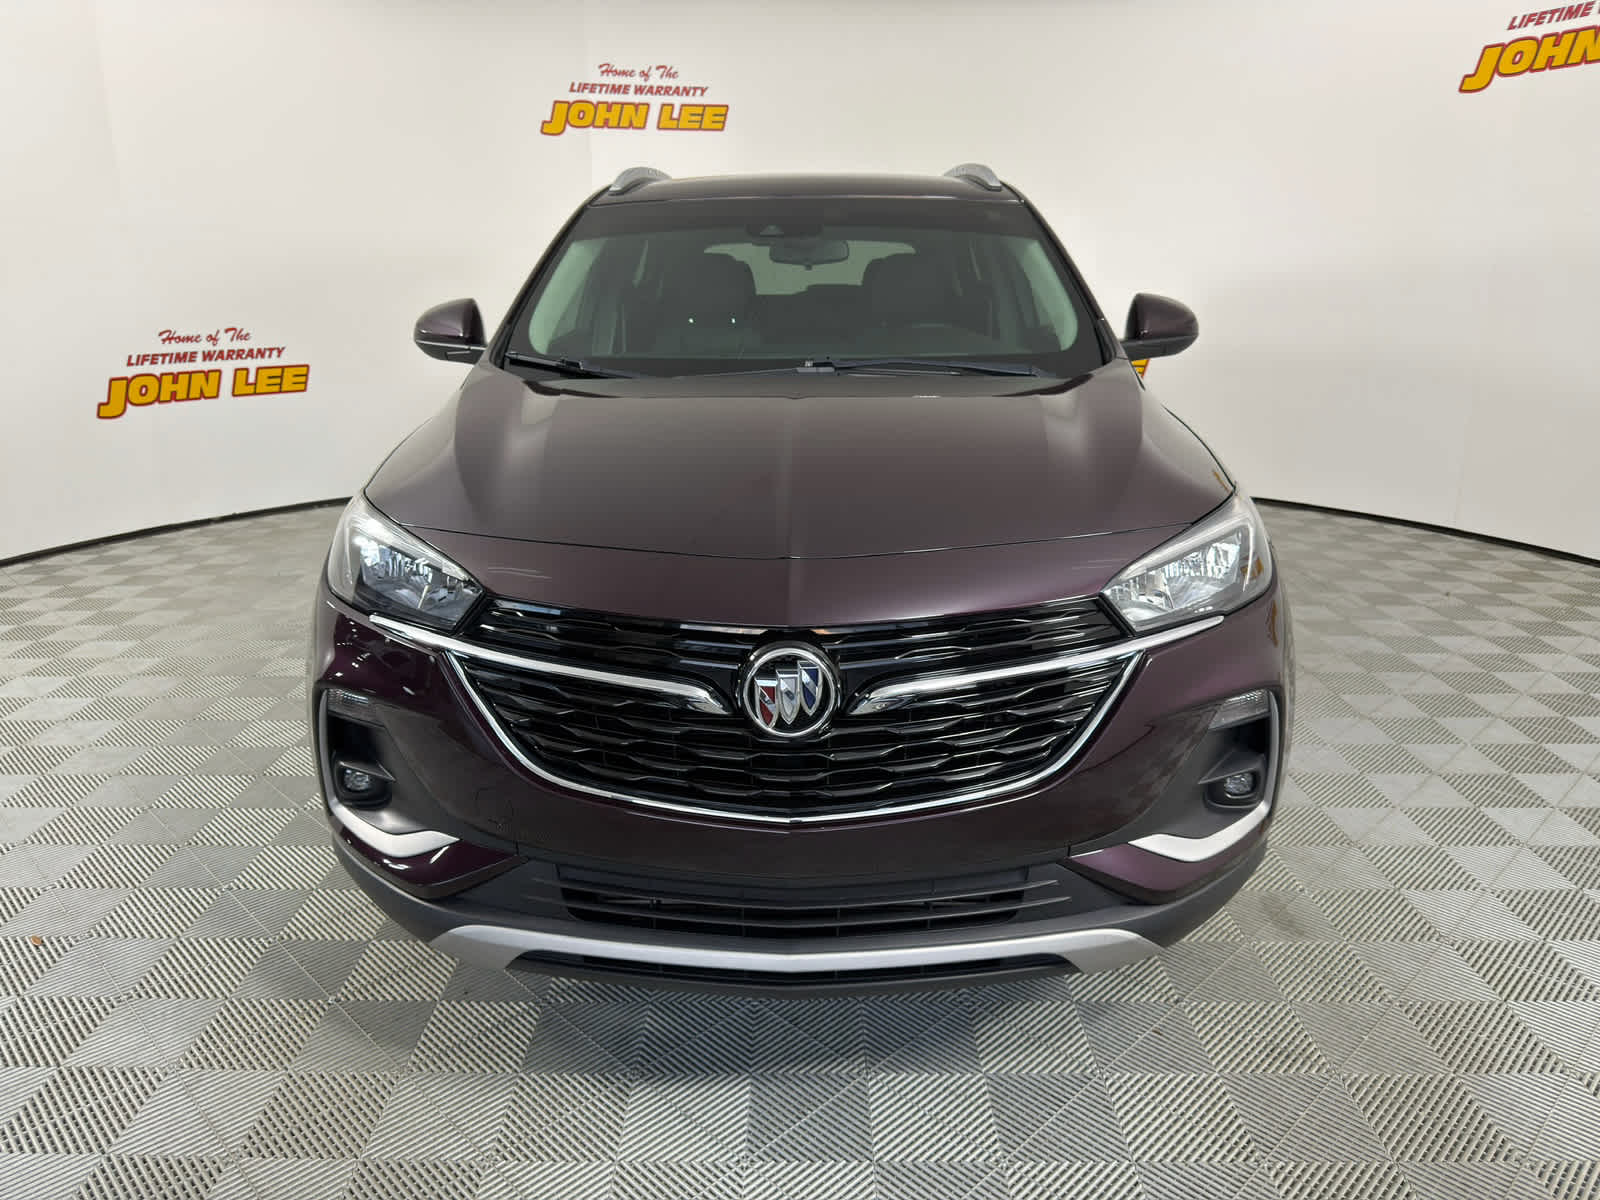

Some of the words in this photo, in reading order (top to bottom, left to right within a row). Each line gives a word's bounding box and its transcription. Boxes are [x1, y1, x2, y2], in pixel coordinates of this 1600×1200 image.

[1507, 1, 1595, 31] LIFETIME
[1458, 24, 1600, 94] JOHN
[598, 63, 636, 79] Home
[639, 66, 653, 82] of
[655, 65, 679, 80] The
[569, 82, 631, 95] LIFETIME
[634, 84, 708, 97] WARRANTY
[540, 99, 650, 136] JOHN
[657, 103, 729, 132] LEE
[158, 329, 201, 345] Home
[205, 329, 220, 346] of
[224, 326, 251, 342] The
[126, 350, 198, 367] LIFETIME
[201, 346, 286, 363] WARRANTY
[96, 369, 222, 420] JOHN
[231, 363, 310, 398] LEE
